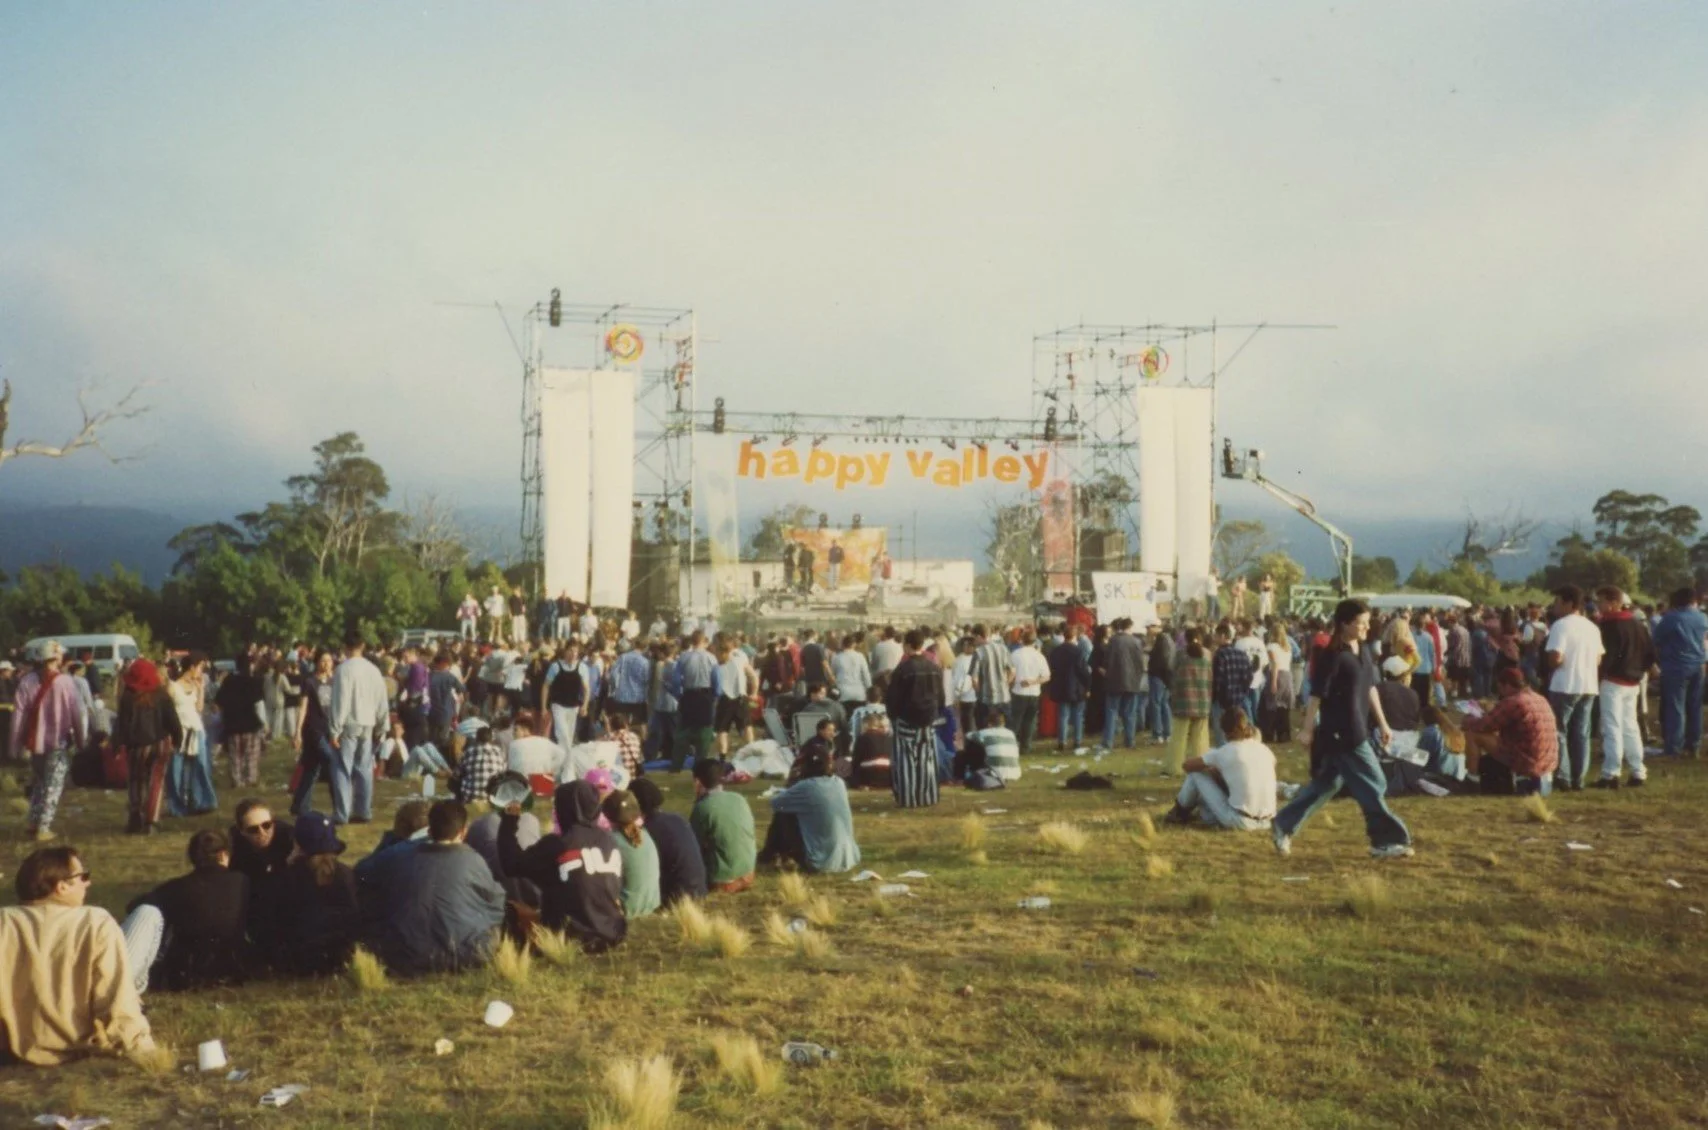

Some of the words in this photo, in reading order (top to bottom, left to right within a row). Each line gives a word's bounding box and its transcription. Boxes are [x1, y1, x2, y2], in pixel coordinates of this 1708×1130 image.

[736, 440, 891, 491] happy
[905, 444, 1049, 490] valley
[557, 847, 621, 881] FILA
